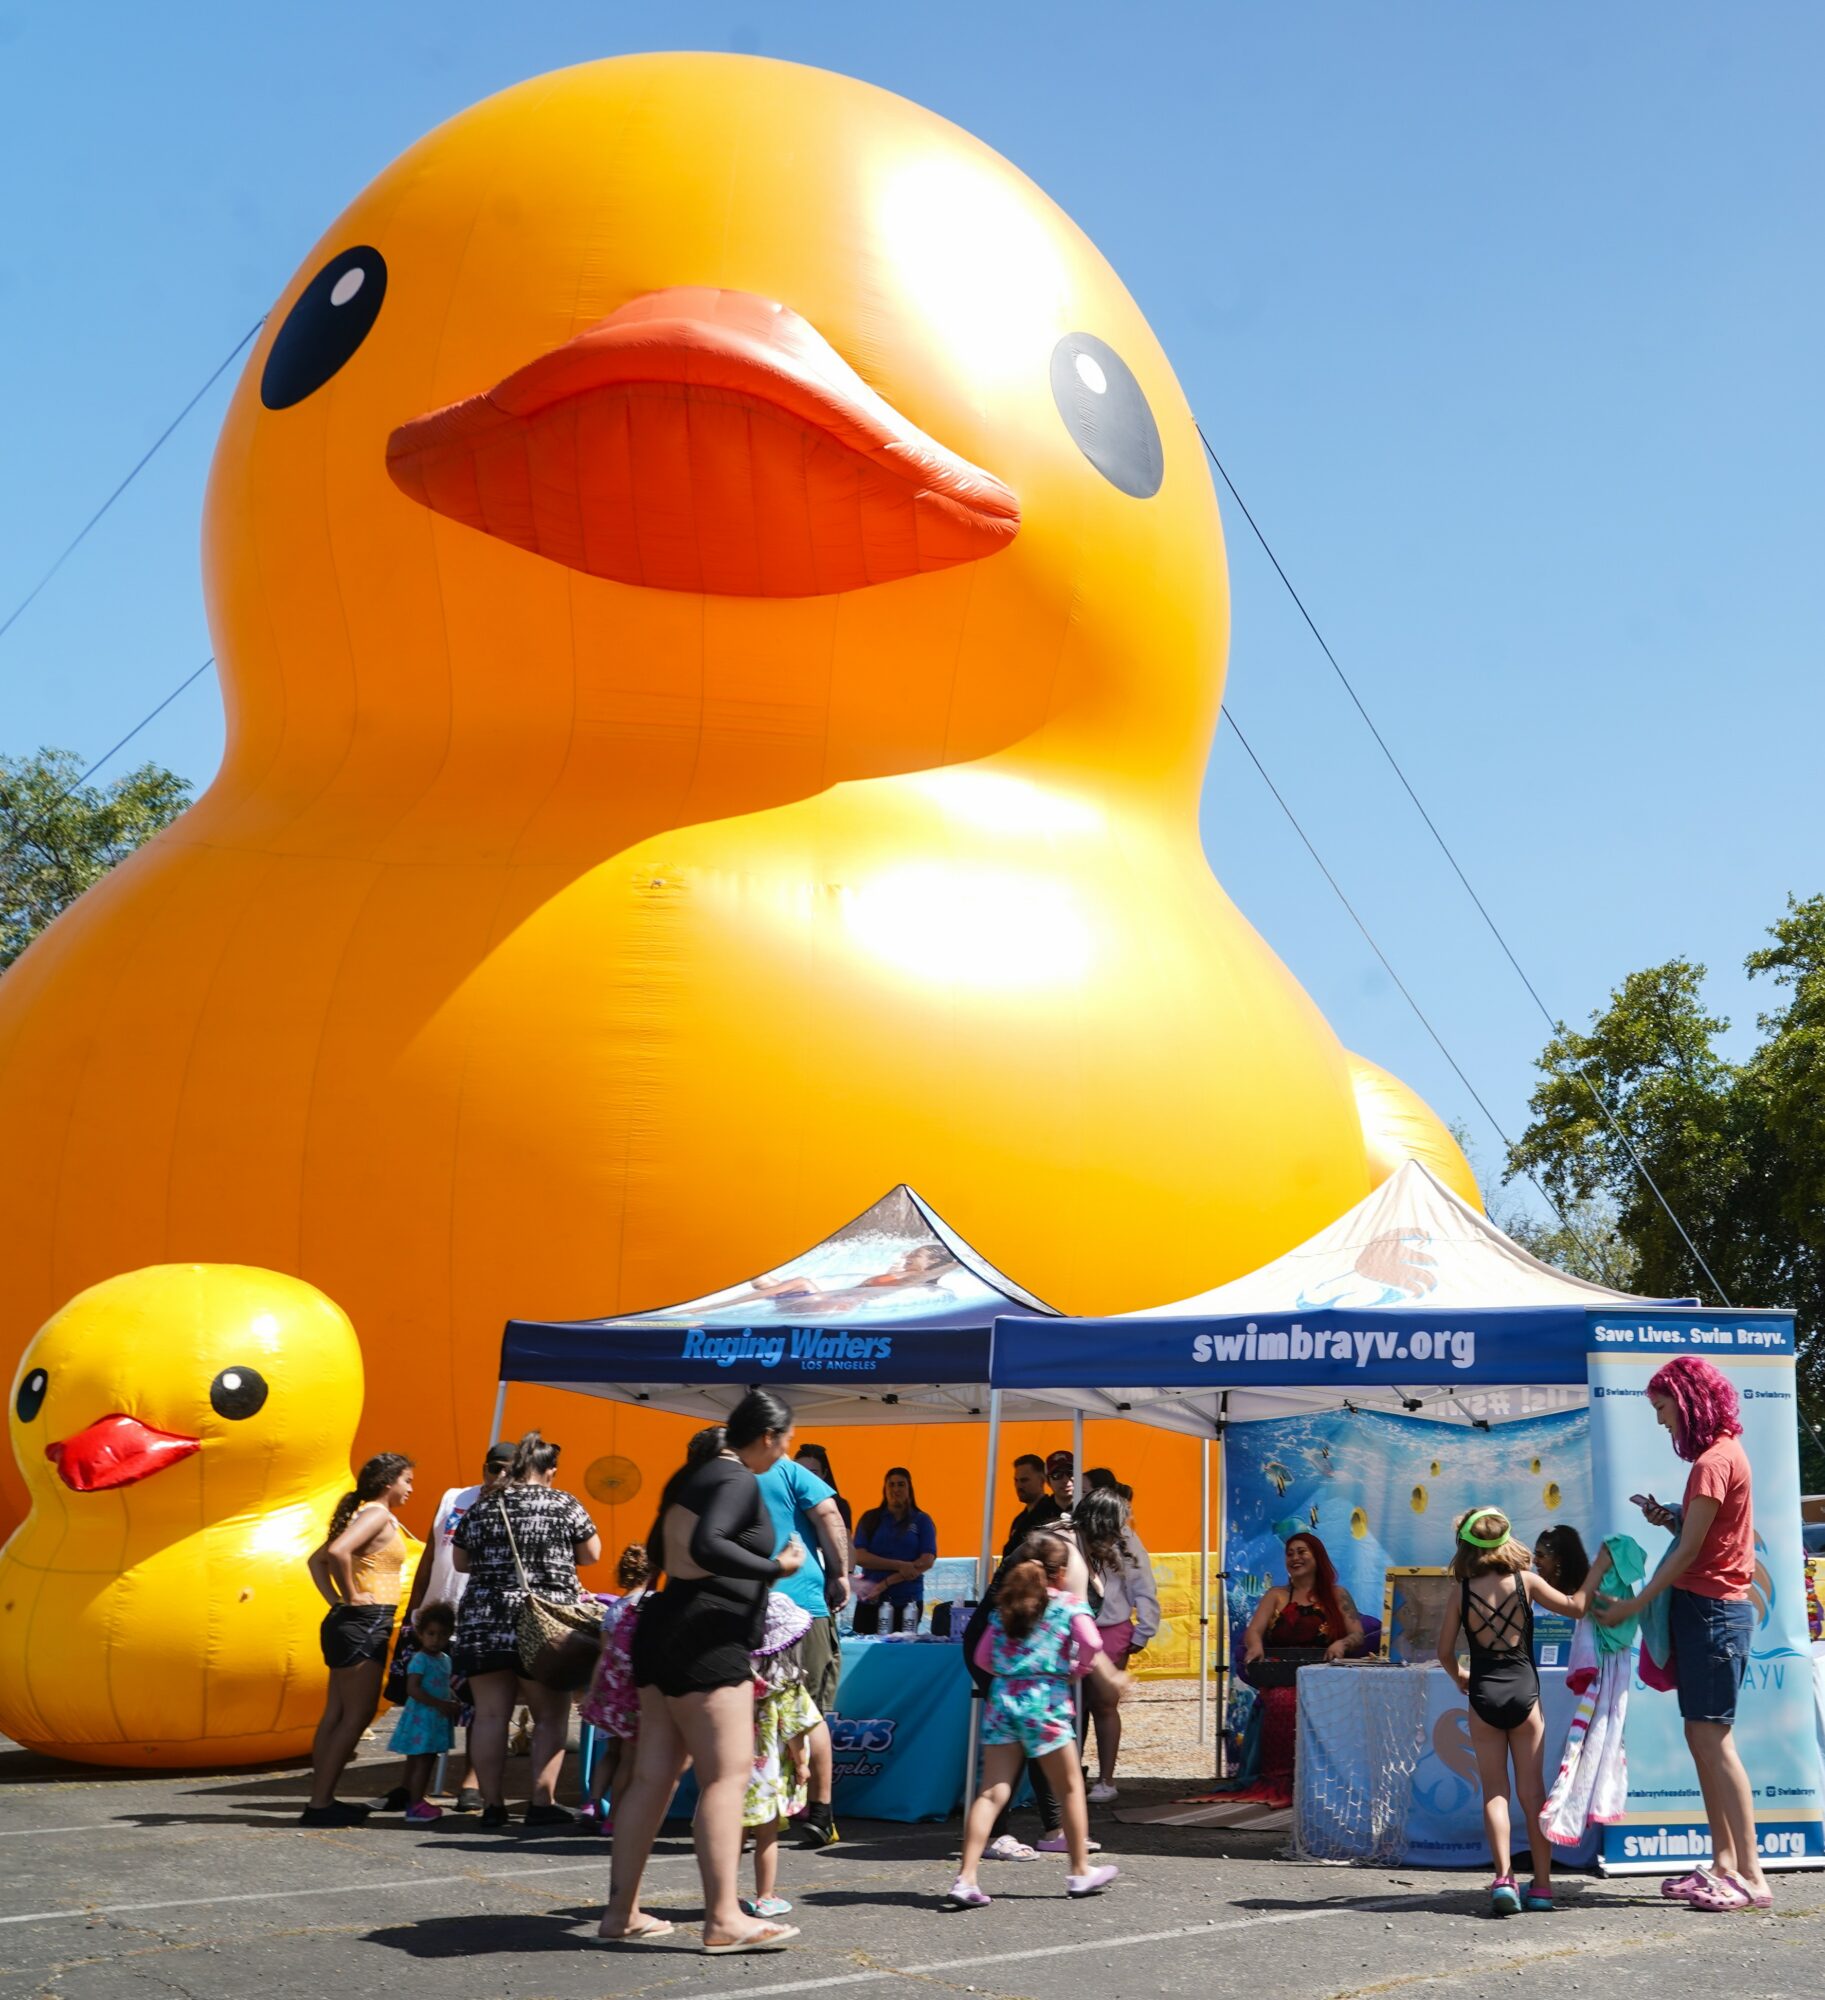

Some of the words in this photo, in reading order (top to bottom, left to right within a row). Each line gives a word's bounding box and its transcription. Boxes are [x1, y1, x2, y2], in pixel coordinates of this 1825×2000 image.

[682, 1328, 785, 1367] Raging
[790, 1329, 892, 1359] Waters
[1192, 1323, 1475, 1368] swimbrayv.org
[1595, 1326, 1634, 1342] Save
[1639, 1327, 1686, 1343] Lives.
[1691, 1328, 1733, 1344] Swim
[1738, 1328, 1786, 1347] Brayv.
[802, 1361, 822, 1370] LOS
[826, 1361, 876, 1370] ANGELES
[1606, 1388, 1646, 1397] Swimbrayv
[824, 1711, 897, 1751] ters
[833, 1756, 881, 1783] geles
[1627, 1789, 1700, 1798] wimbrayvfoundation
[1624, 1828, 1806, 1857] swimbr.org
